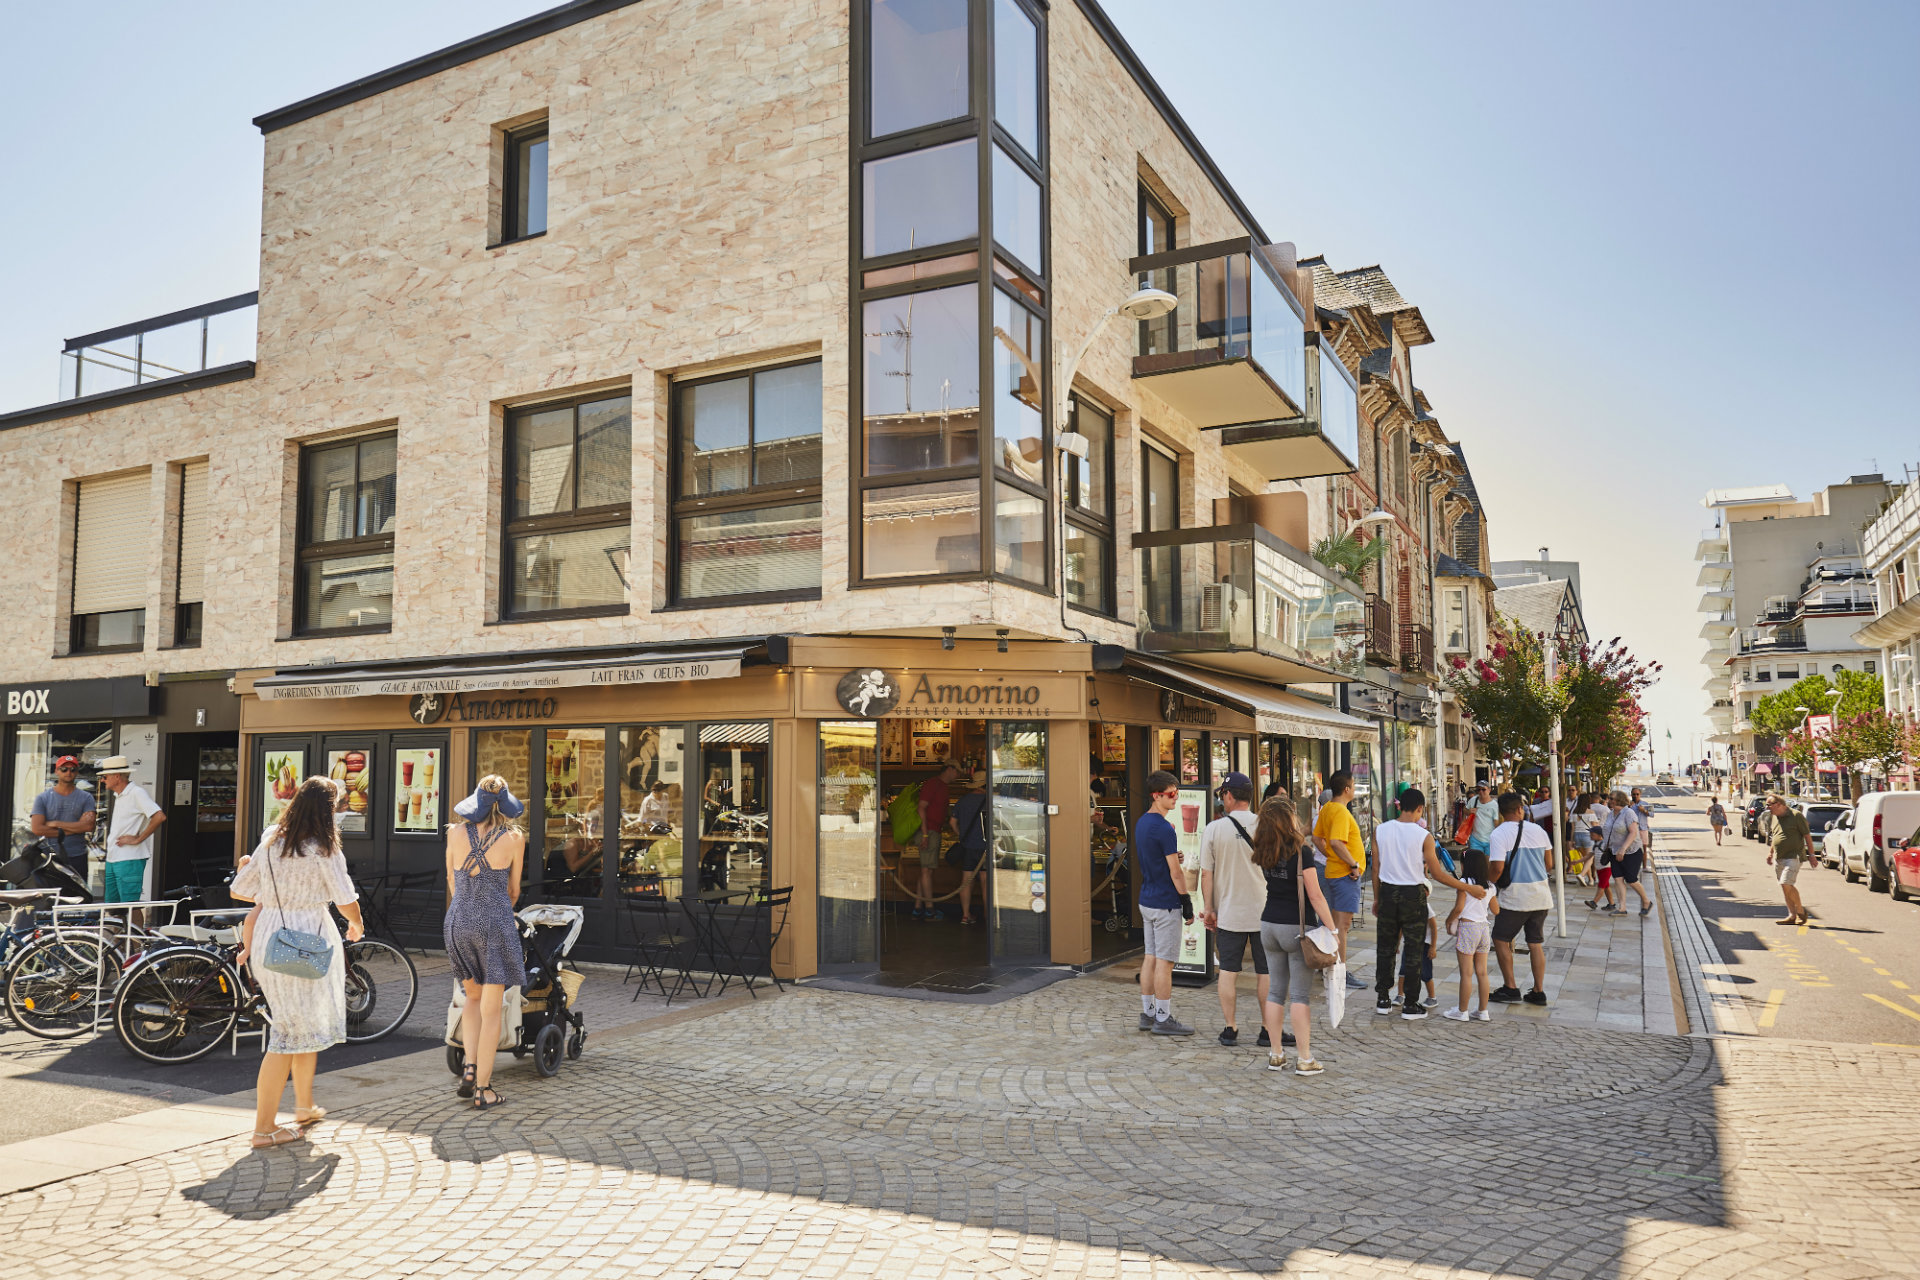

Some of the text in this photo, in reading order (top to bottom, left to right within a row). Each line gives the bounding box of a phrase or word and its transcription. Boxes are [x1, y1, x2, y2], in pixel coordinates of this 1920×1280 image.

[591, 669, 644, 682] LAIT FRAIS
[653, 664, 709, 679] OEUFS BIO
[323, 684, 361, 696] NATURELS
[380, 680, 461, 693] GLACE ARTISANALE
[908, 672, 1040, 705] Amorino
[8, 689, 50, 715] BOX
[444, 690, 558, 721] Amorino
[895, 706, 1051, 717] GELATO AL NATURALE
